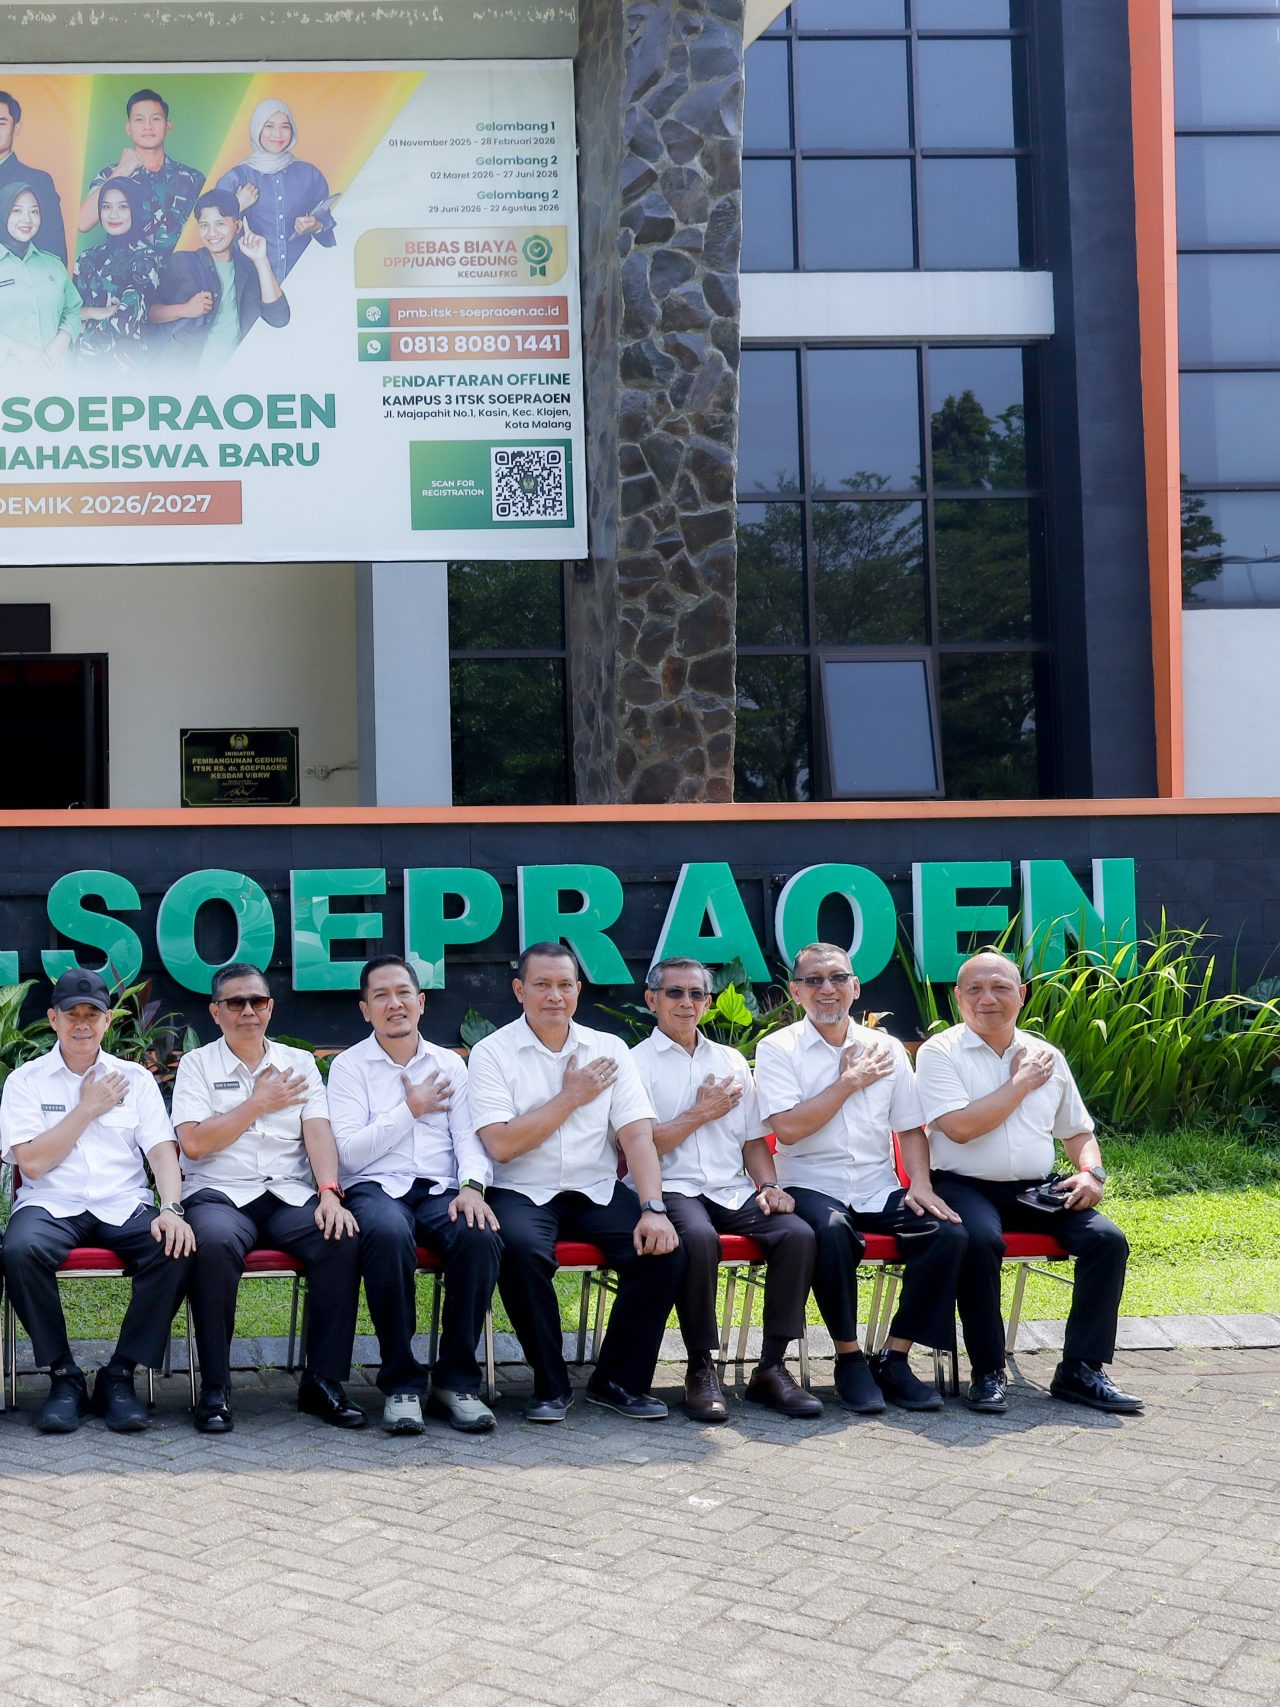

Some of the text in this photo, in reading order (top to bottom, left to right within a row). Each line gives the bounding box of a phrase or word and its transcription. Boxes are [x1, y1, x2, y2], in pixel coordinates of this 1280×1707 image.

[476, 121, 555, 133] Gelombang 1
[389, 139, 398, 147] 01
[481, 137, 492, 145] 28
[494, 137, 532, 145] Februari
[534, 137, 556, 145] 2026
[476, 155, 558, 168] Gelombang 2
[472, 171, 494, 179] 2026
[516, 170, 534, 178] Juni
[537, 170, 558, 178] 2026
[477, 190, 559, 202] Gelombang 2
[441, 205, 459, 213] Juni
[461, 205, 481, 213] 2026
[502, 205, 537, 214] Agustus
[405, 240, 518, 254] BEBAS BIAYA
[384, 256, 518, 268] DPP/UANG GEDUNG
[458, 270, 518, 278] KECUALI FKG
[398, 306, 560, 321] pmb.itsk-soepraoen.ac.id
[400, 335, 560, 353] 0813 8080 1441
[383, 373, 570, 387] PENDAFTARAN OFFLINE
[383, 393, 570, 406] KAMPUS 3 ITSK SOEPRAOEN
[2, 394, 336, 433] SOEPRAOEN
[384, 410, 394, 418] Jl.
[397, 409, 451, 420] Majapahit
[454, 409, 476, 418] No.1,
[479, 408, 510, 417] Kasin,
[537, 407, 571, 418] Klojen,
[505, 420, 571, 431] Kota Malang
[219, 442, 320, 467] BARU
[80, 492, 211, 515] 2026/2027
[41, 858, 1139, 996] SOEPRAOEN
